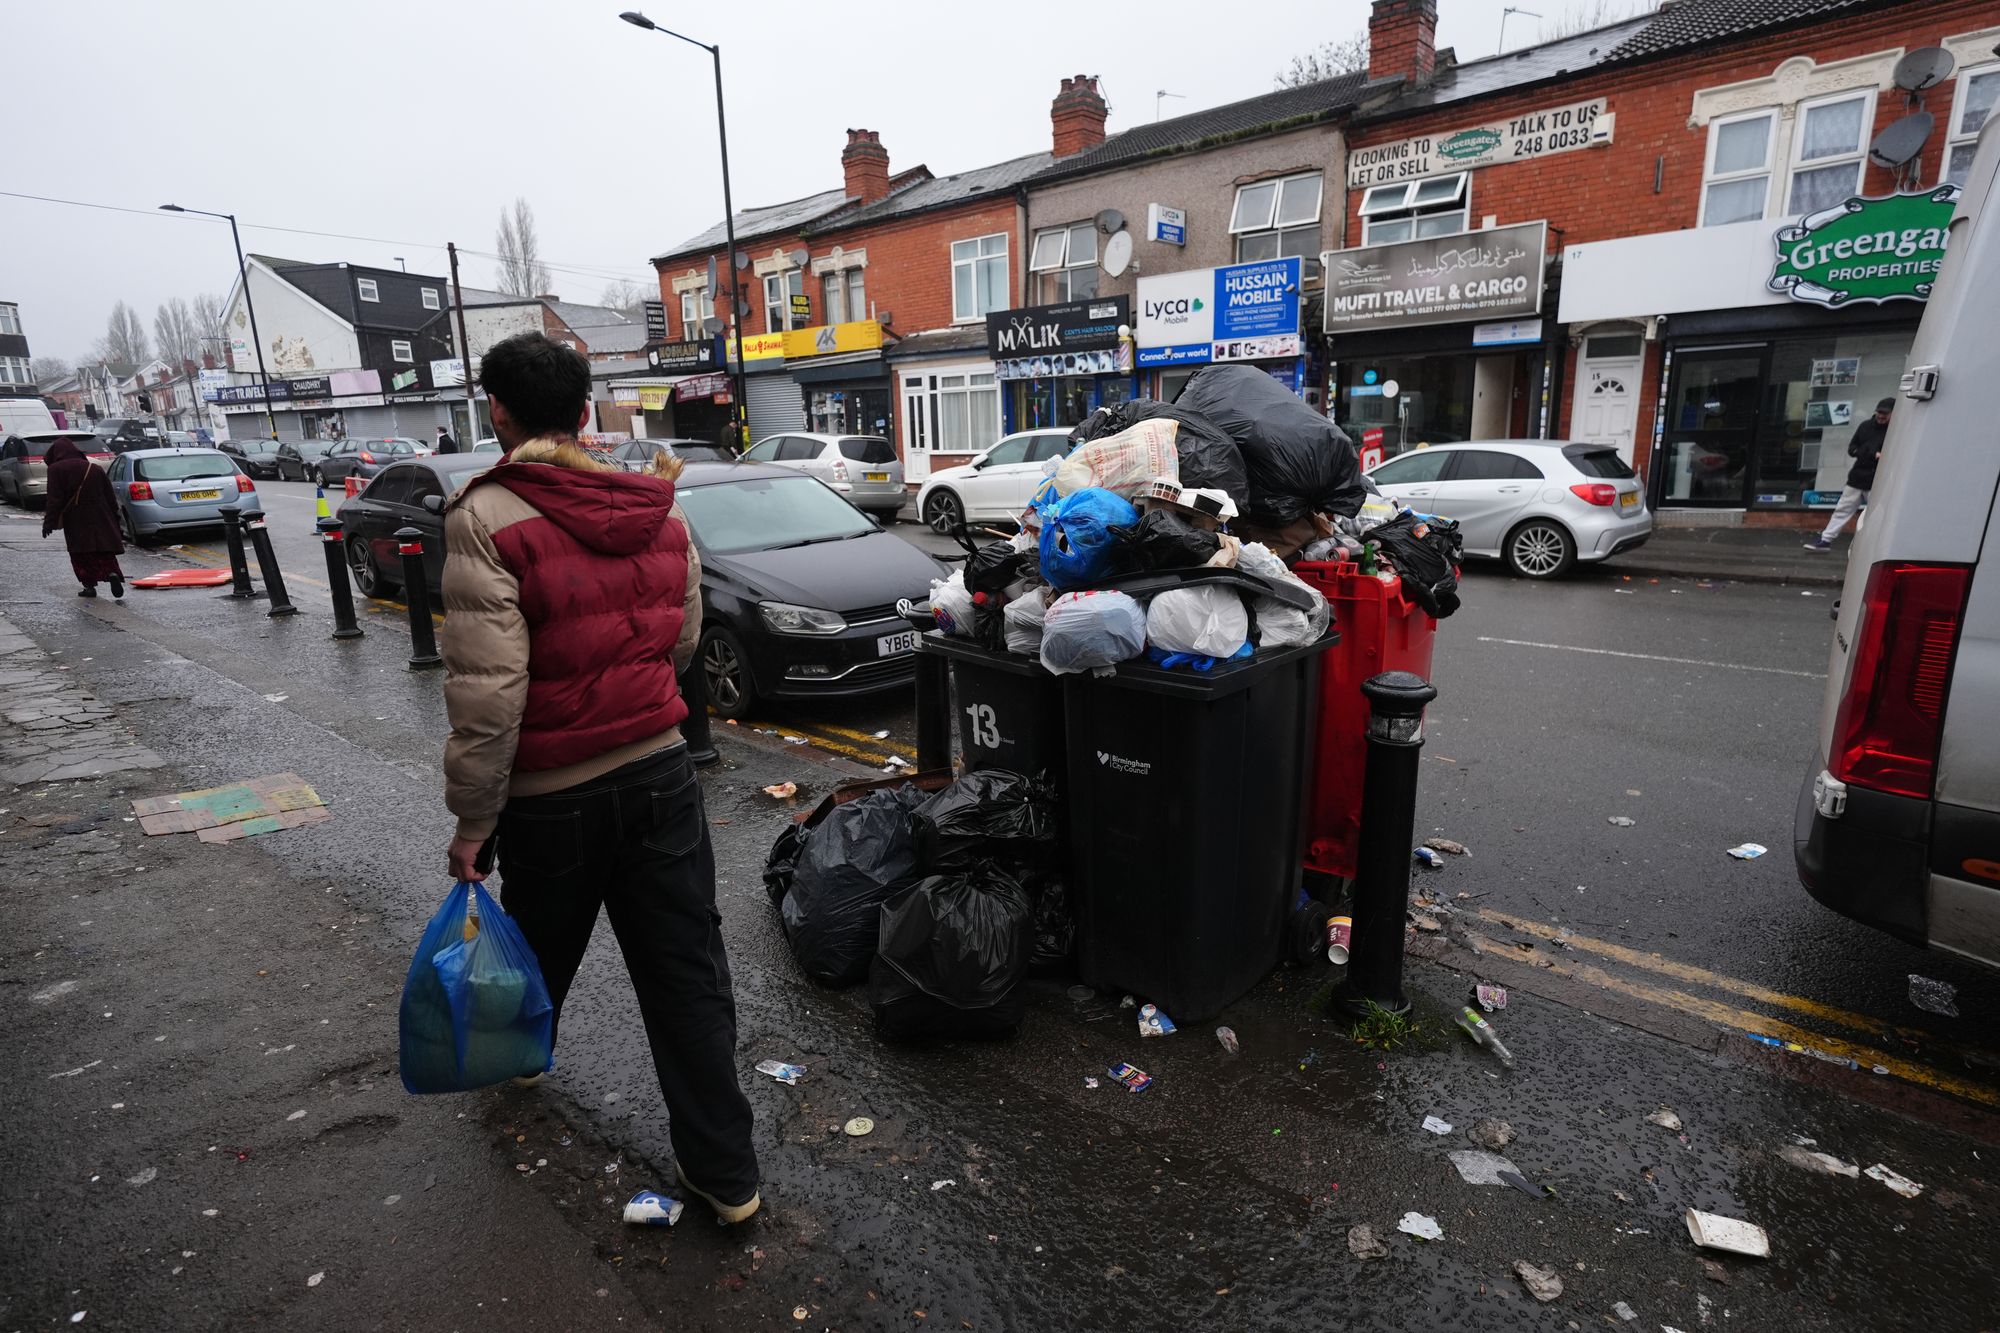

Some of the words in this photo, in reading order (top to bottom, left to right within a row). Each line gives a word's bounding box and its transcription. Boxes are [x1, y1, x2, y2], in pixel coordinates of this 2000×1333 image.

[1509, 115, 1547, 137] TALK
[1552, 112, 1571, 129] TO
[1577, 104, 1599, 123] US
[1441, 136, 1496, 153] Greengates
[1514, 136, 1542, 157] 248
[1549, 127, 1589, 150] 0033
[1354, 142, 1409, 168] LOOKING
[1414, 138, 1431, 154] TO
[1351, 168, 1372, 186] LET
[1377, 164, 1395, 181] OR
[1399, 157, 1430, 176] SELL
[1572, 251, 1582, 259] 17
[1828, 259, 1943, 281] PROPERTIES
[1225, 271, 1287, 292] HUSSAIN
[1229, 287, 1283, 307] MOBILE
[1334, 292, 1380, 312] MUFTI
[1384, 284, 1445, 307] TRAVEL
[1449, 283, 1461, 300] &
[1464, 275, 1528, 298] CARGO
[1145, 298, 1189, 320] Lyca
[1351, 312, 1374, 320] Transfer
[1374, 309, 1404, 318] Worldwide
[1163, 315, 1189, 325] Mobile
[1187, 347, 1209, 358] world
[235, 385, 266, 400] TRAVELS
[292, 380, 321, 391] CHAUDHRY
[966, 703, 1000, 749] 13
[1112, 754, 1151, 769] Birmingham
[1112, 762, 1124, 772] City
[1124, 764, 1149, 775] Council
